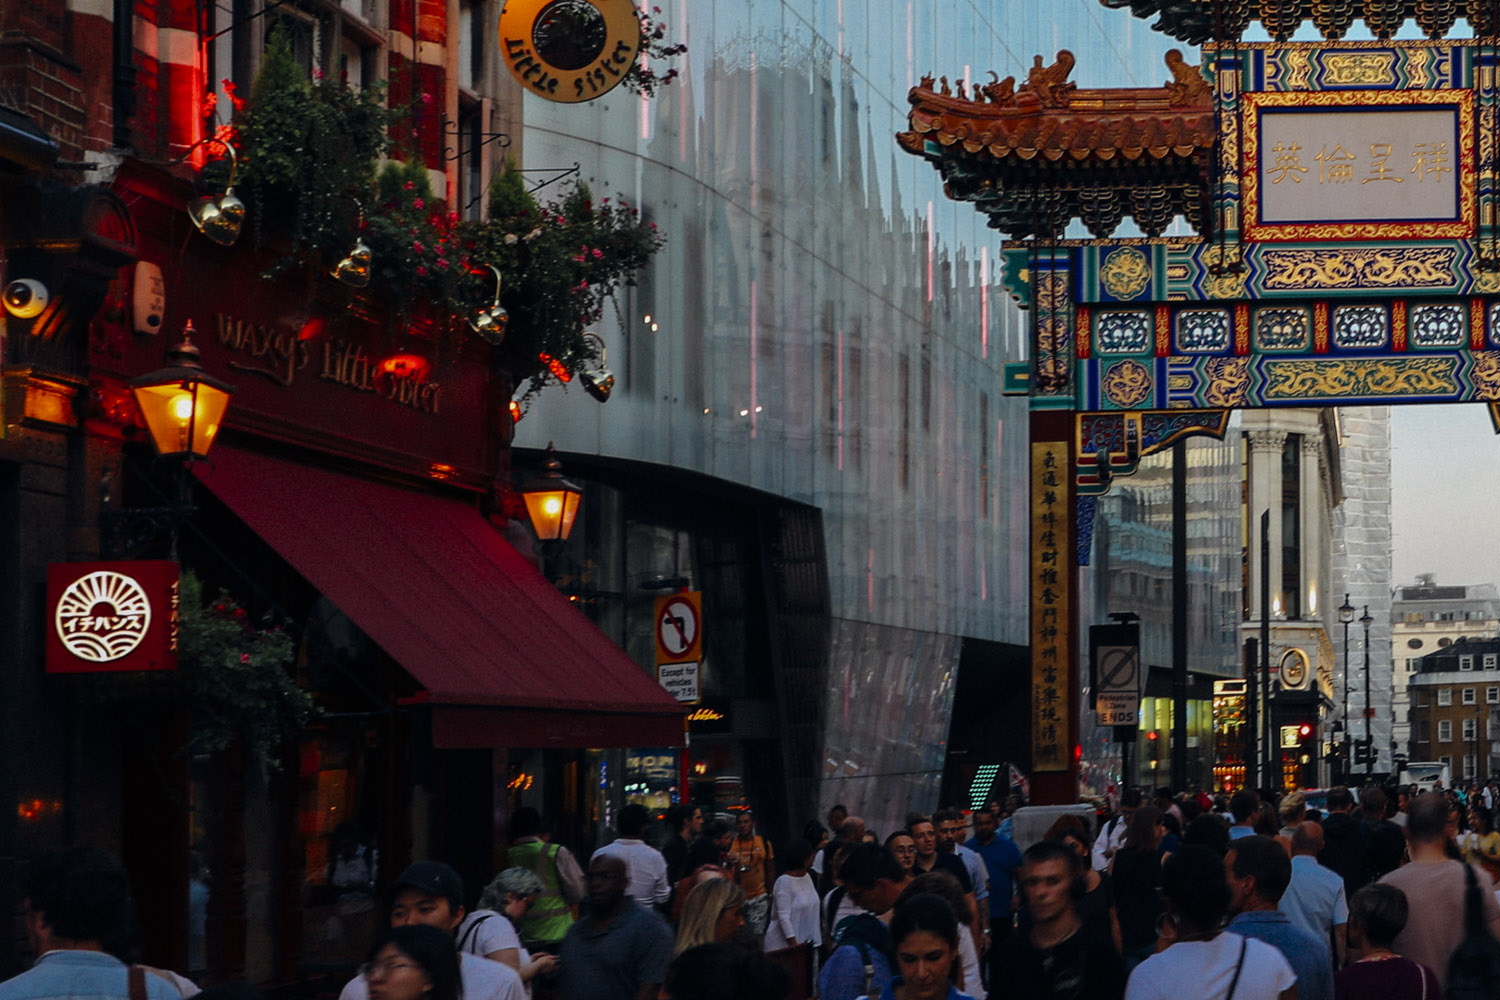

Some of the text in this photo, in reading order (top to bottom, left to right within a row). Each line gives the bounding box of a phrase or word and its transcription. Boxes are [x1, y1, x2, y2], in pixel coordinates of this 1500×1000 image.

[1265, 140, 1453, 185] 英倫呈祥
[661, 667, 696, 679] Except for
[665, 678, 692, 687] vehicles
[1101, 712, 1134, 722] ENDS
